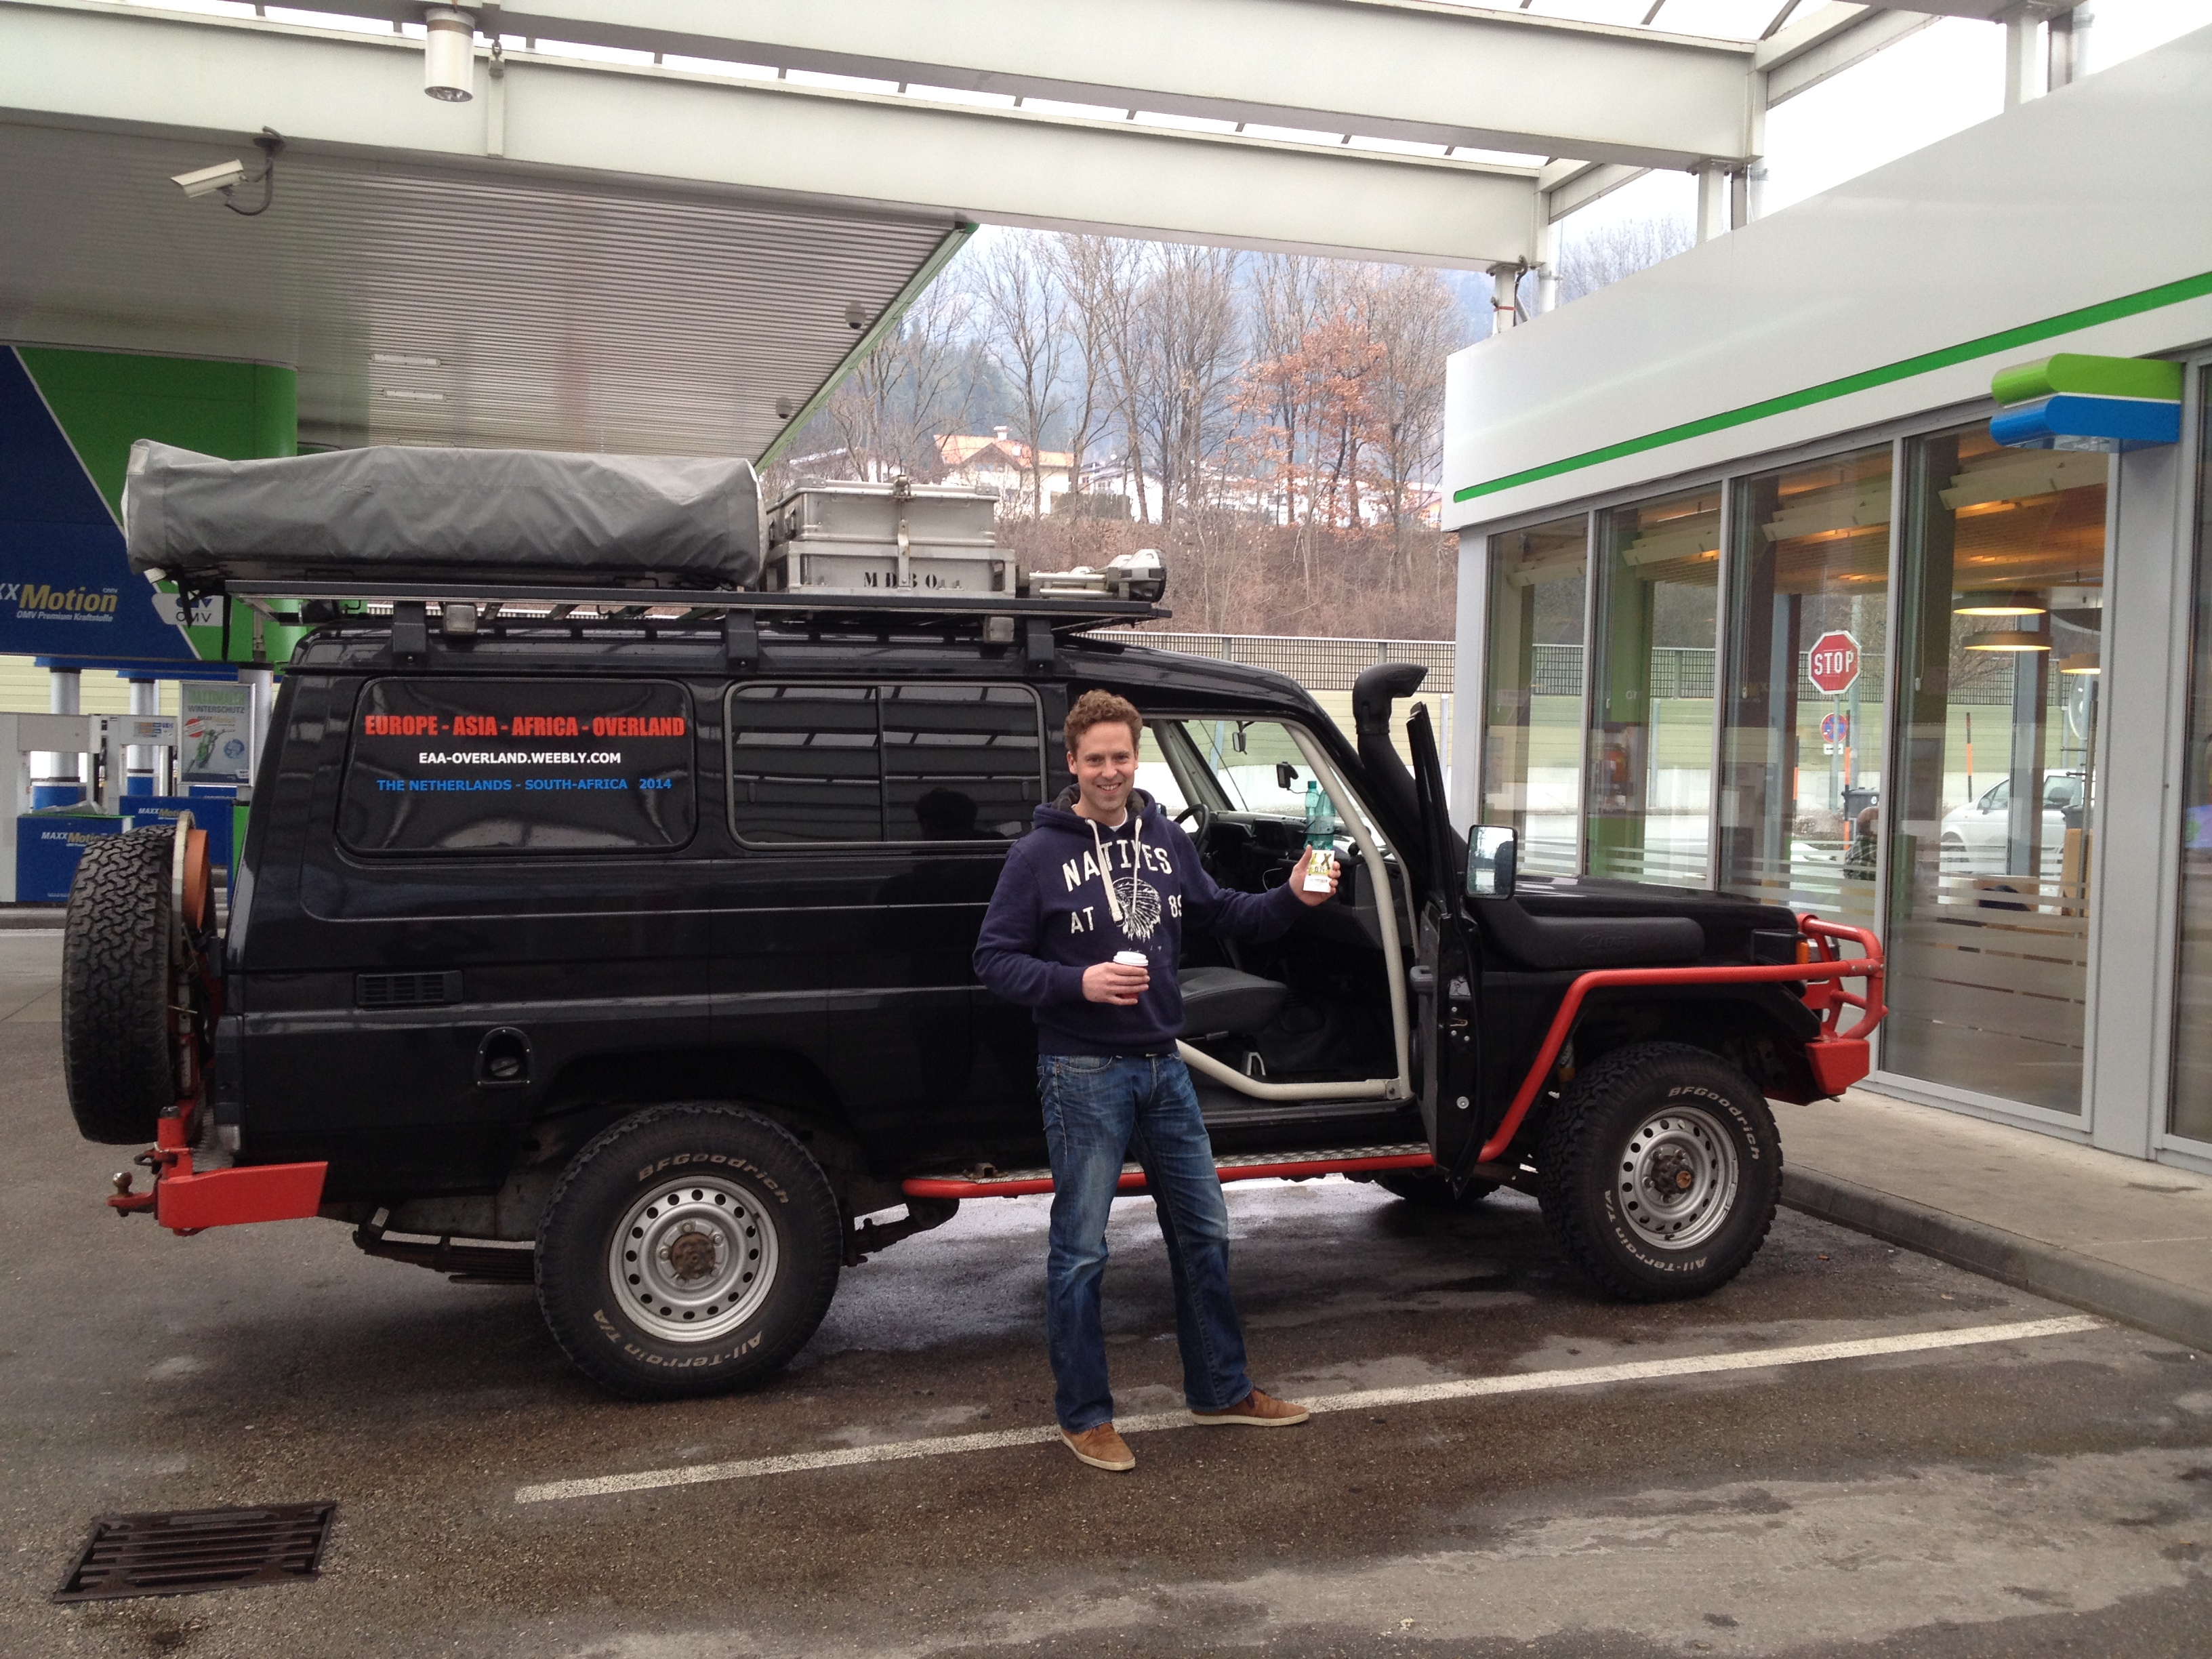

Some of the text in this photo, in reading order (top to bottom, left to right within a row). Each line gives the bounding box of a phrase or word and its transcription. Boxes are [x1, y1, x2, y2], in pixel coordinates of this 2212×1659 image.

[19, 584, 117, 612] Motion
[38, 611, 73, 620] Premium
[74, 613, 113, 621] Kraftstoffe
[1814, 650, 1854, 676] STOP
[365, 716, 438, 735] EUROPE
[453, 716, 497, 736] ASIA
[512, 716, 578, 736] AFRICA
[592, 717, 685, 736] OVERLAND
[419, 752, 621, 764] EAA-OVERLAND.WEEBLY.COM
[377, 780, 405, 791] THE
[409, 779, 512, 791] NETHERLANDS
[525, 779, 628, 790] SOUTH-AFRICA
[639, 779, 672, 790] 2014
[41, 832, 68, 840] MAXX
[1071, 906, 1094, 934] AT
[1668, 1086, 1760, 1160] BFGoodrich
[639, 1153, 789, 1204] BFGoodrich
[1604, 1189, 1708, 1271] All-Terrain T/A
[593, 1309, 762, 1368] All-Terrain T/A
